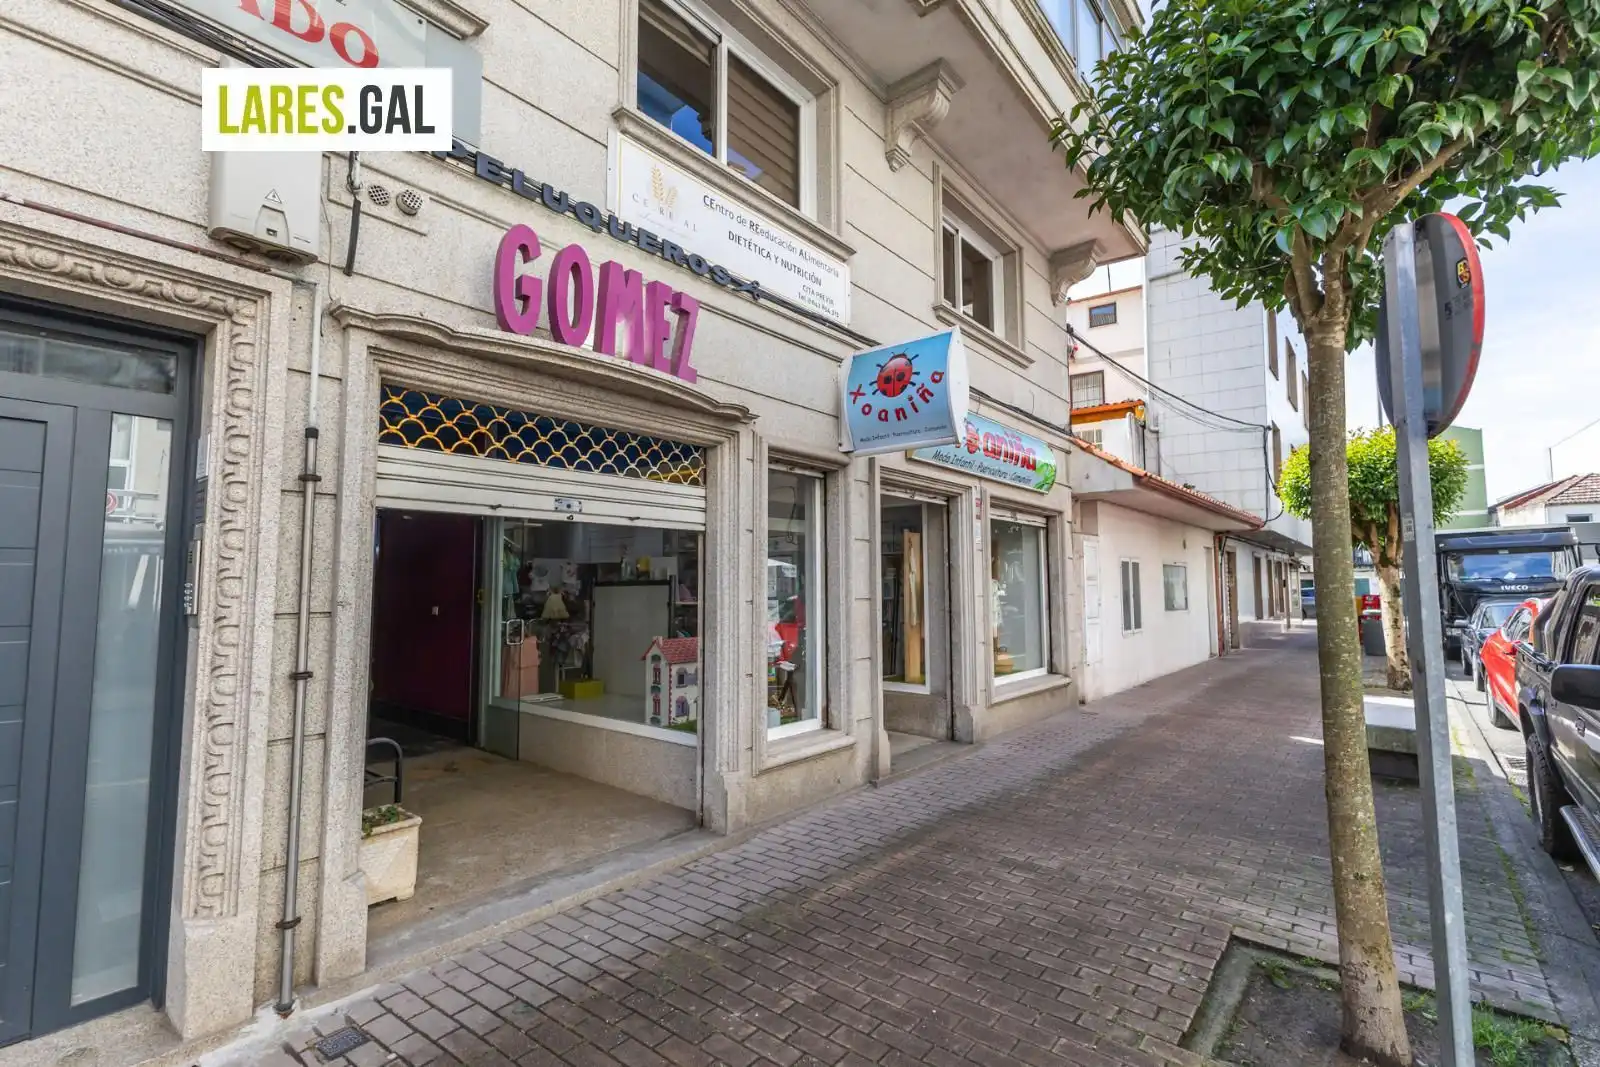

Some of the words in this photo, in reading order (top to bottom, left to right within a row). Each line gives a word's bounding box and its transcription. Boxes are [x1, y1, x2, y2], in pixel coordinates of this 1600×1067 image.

[237, 0, 380, 68] DO
[703, 194, 734, 220] CEntro
[736, 214, 747, 227] de
[749, 220, 797, 255] REeducación
[728, 230, 771, 262] DIETÉTICA
[774, 253, 779, 264] Y
[781, 258, 822, 287] NUTRICIÓN
[493, 223, 700, 385] GOMEZ
[932, 449, 950, 463] Moda
[950, 454, 975, 470] Infantil
